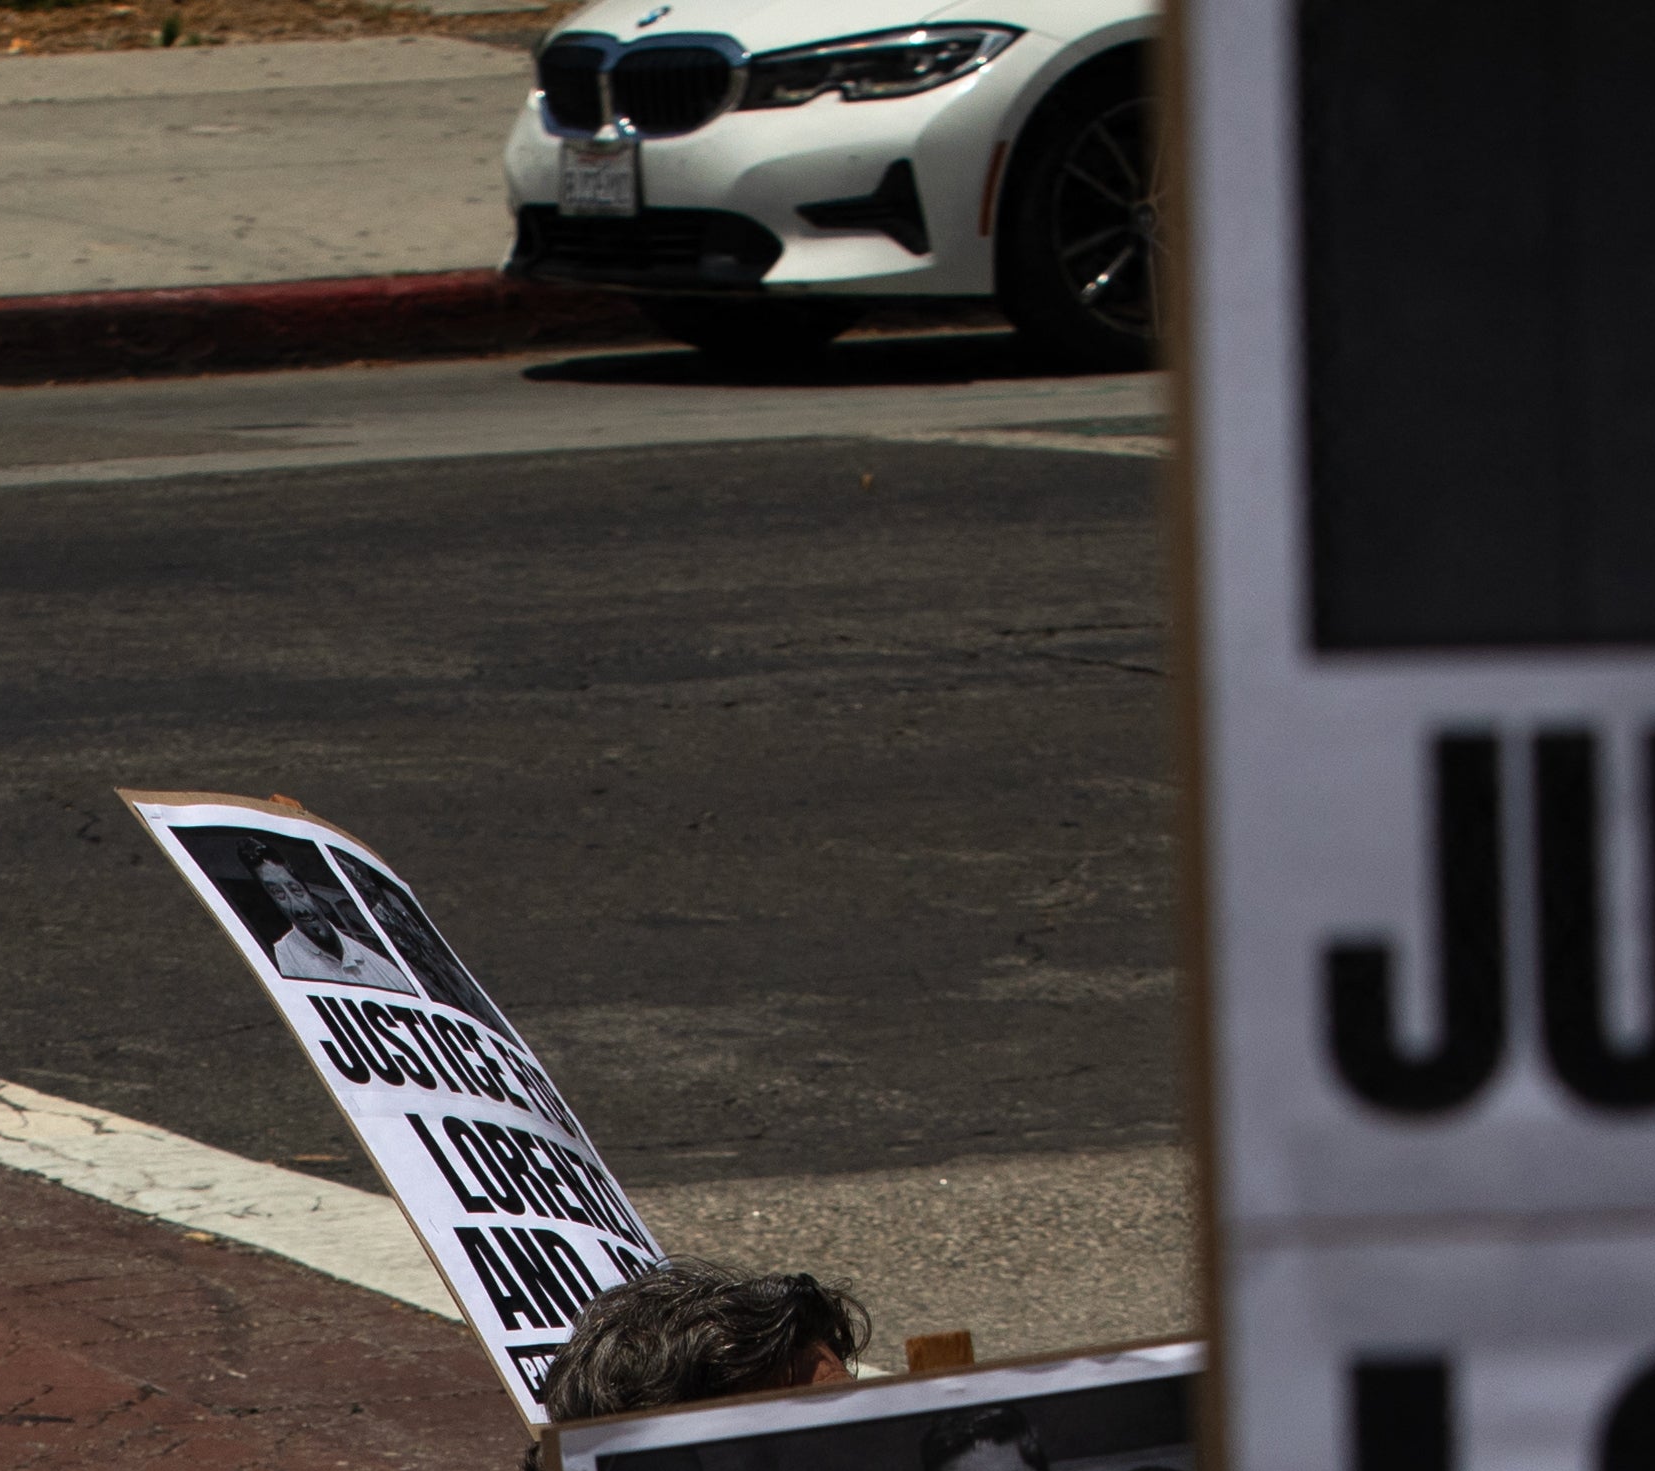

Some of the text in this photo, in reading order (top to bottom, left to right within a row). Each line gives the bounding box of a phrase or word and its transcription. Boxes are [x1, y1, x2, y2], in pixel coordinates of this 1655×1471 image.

[306, 995, 532, 1113] JUSTICE
[405, 1113, 658, 1260] LORENZO
[453, 1226, 603, 1331] AND
